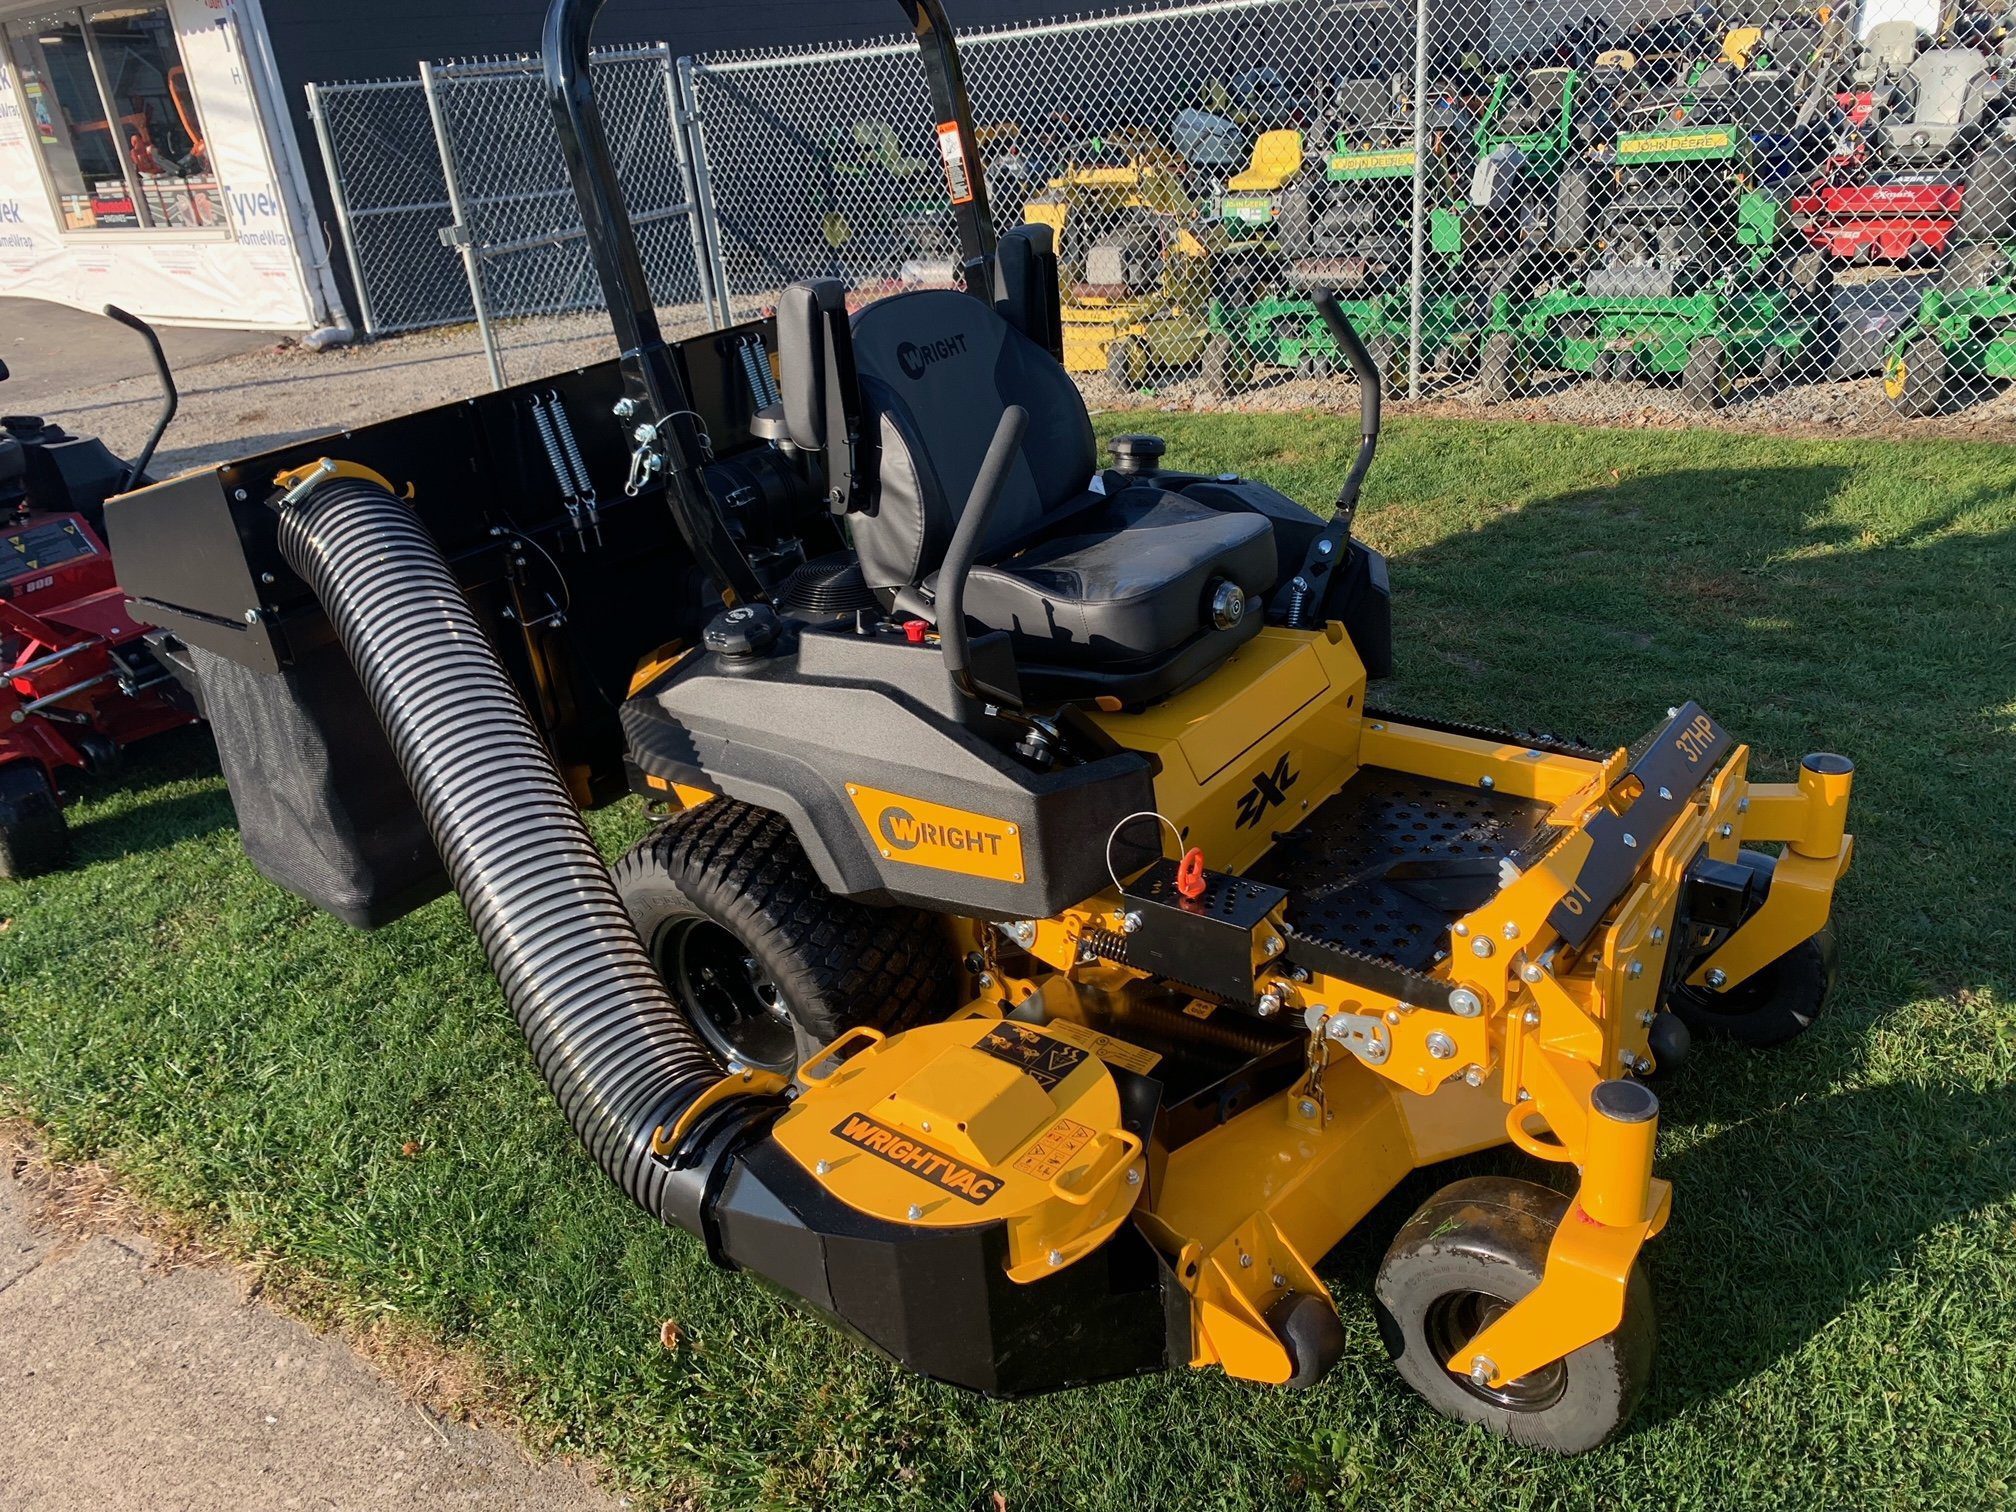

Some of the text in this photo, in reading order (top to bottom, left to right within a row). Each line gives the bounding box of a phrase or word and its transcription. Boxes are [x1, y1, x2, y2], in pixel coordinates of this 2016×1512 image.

[1634, 136, 1714, 151] JOHN DEERE
[897, 333, 967, 381] WRIGHT
[1675, 714, 1717, 764] 37HP
[879, 806, 1002, 856] WRIGHT
